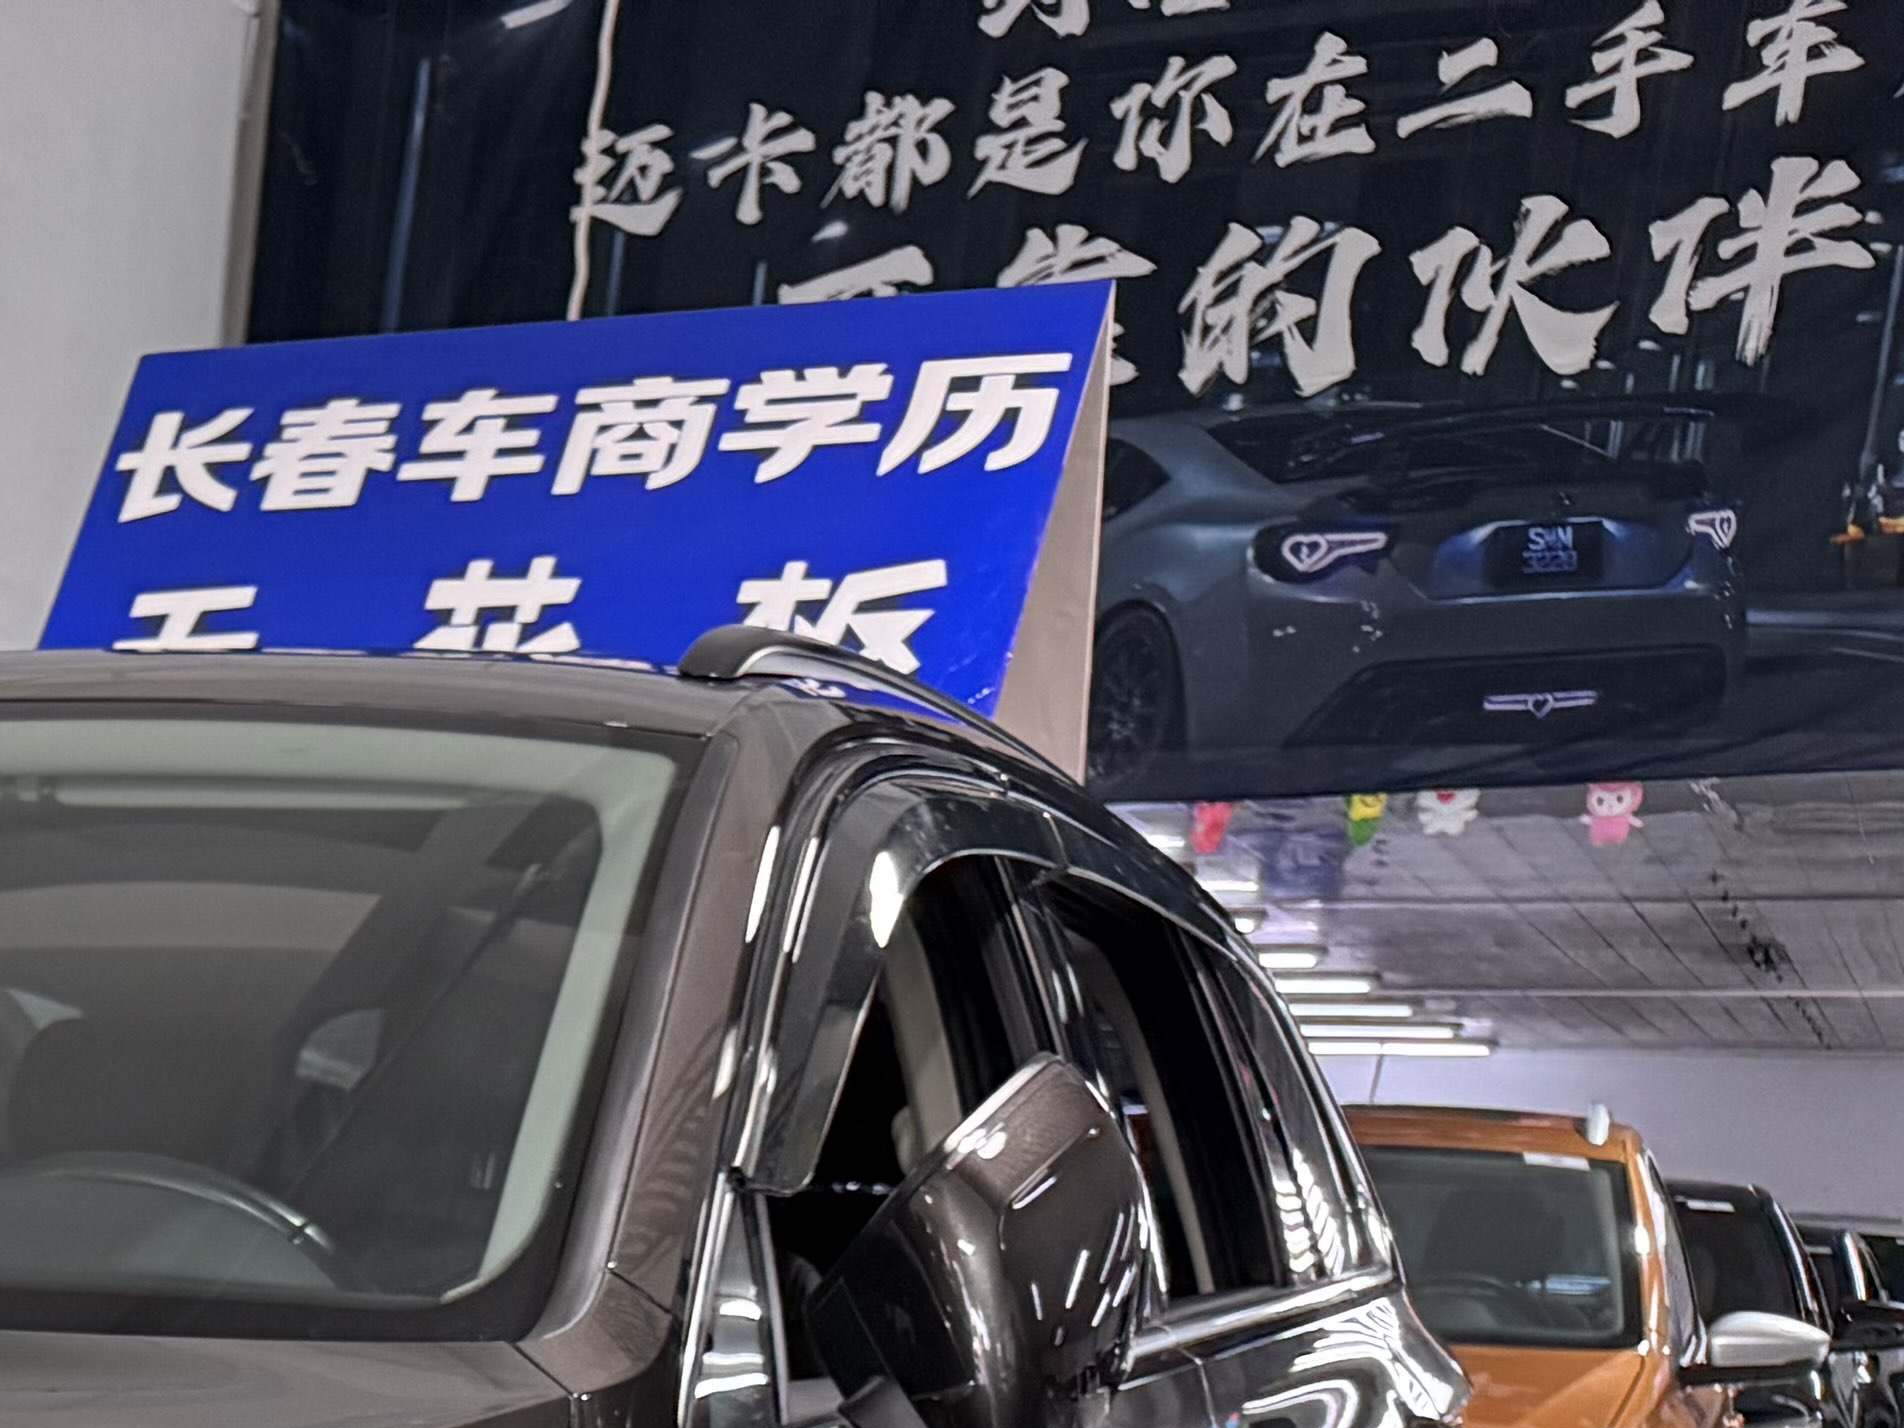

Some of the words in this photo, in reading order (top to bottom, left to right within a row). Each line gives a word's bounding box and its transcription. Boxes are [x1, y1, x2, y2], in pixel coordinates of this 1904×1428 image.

[569, 0, 1904, 236] 迈卡都是你在二手车
[778, 156, 1876, 397] 的伙伴
[114, 352, 1073, 524] 长春车商学历
